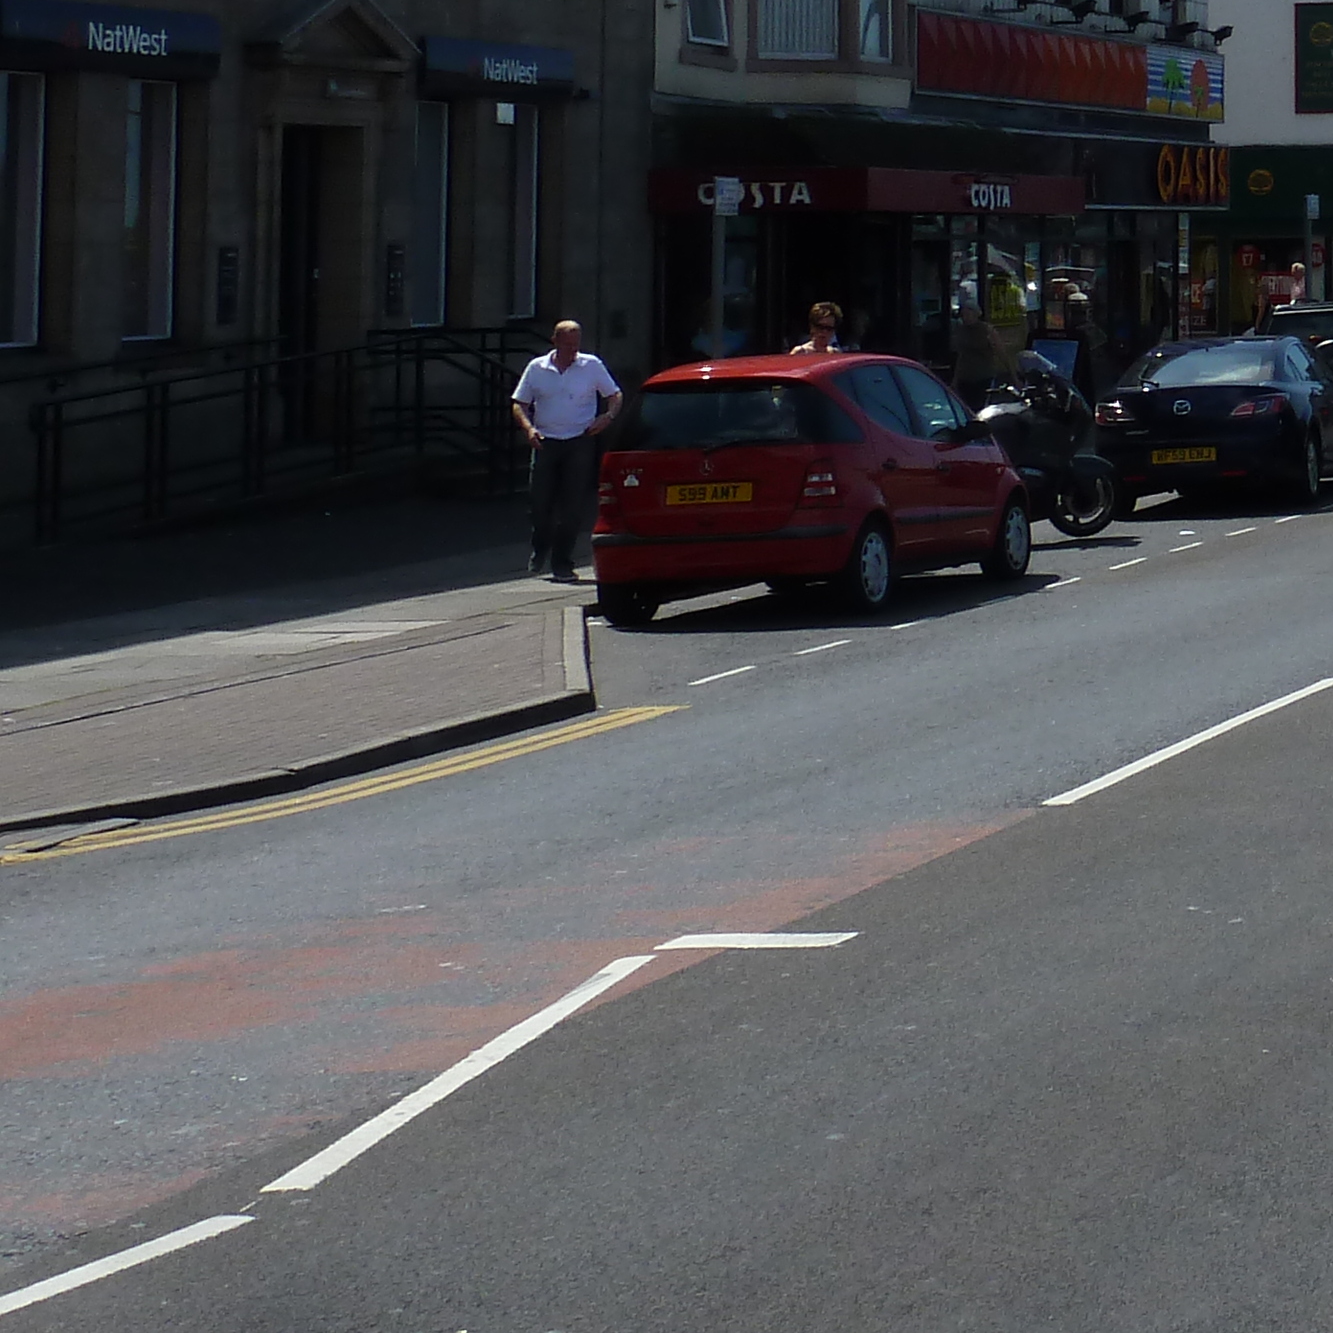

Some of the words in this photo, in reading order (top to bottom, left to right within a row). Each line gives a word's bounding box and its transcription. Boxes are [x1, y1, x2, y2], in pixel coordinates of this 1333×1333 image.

[87, 21, 168, 57] NatWest
[484, 57, 538, 85] NatWest
[1157, 144, 1229, 203] OASIS
[698, 181, 811, 209] CSTA
[971, 183, 1011, 210] COSTA
[678, 487, 706, 502] S99
